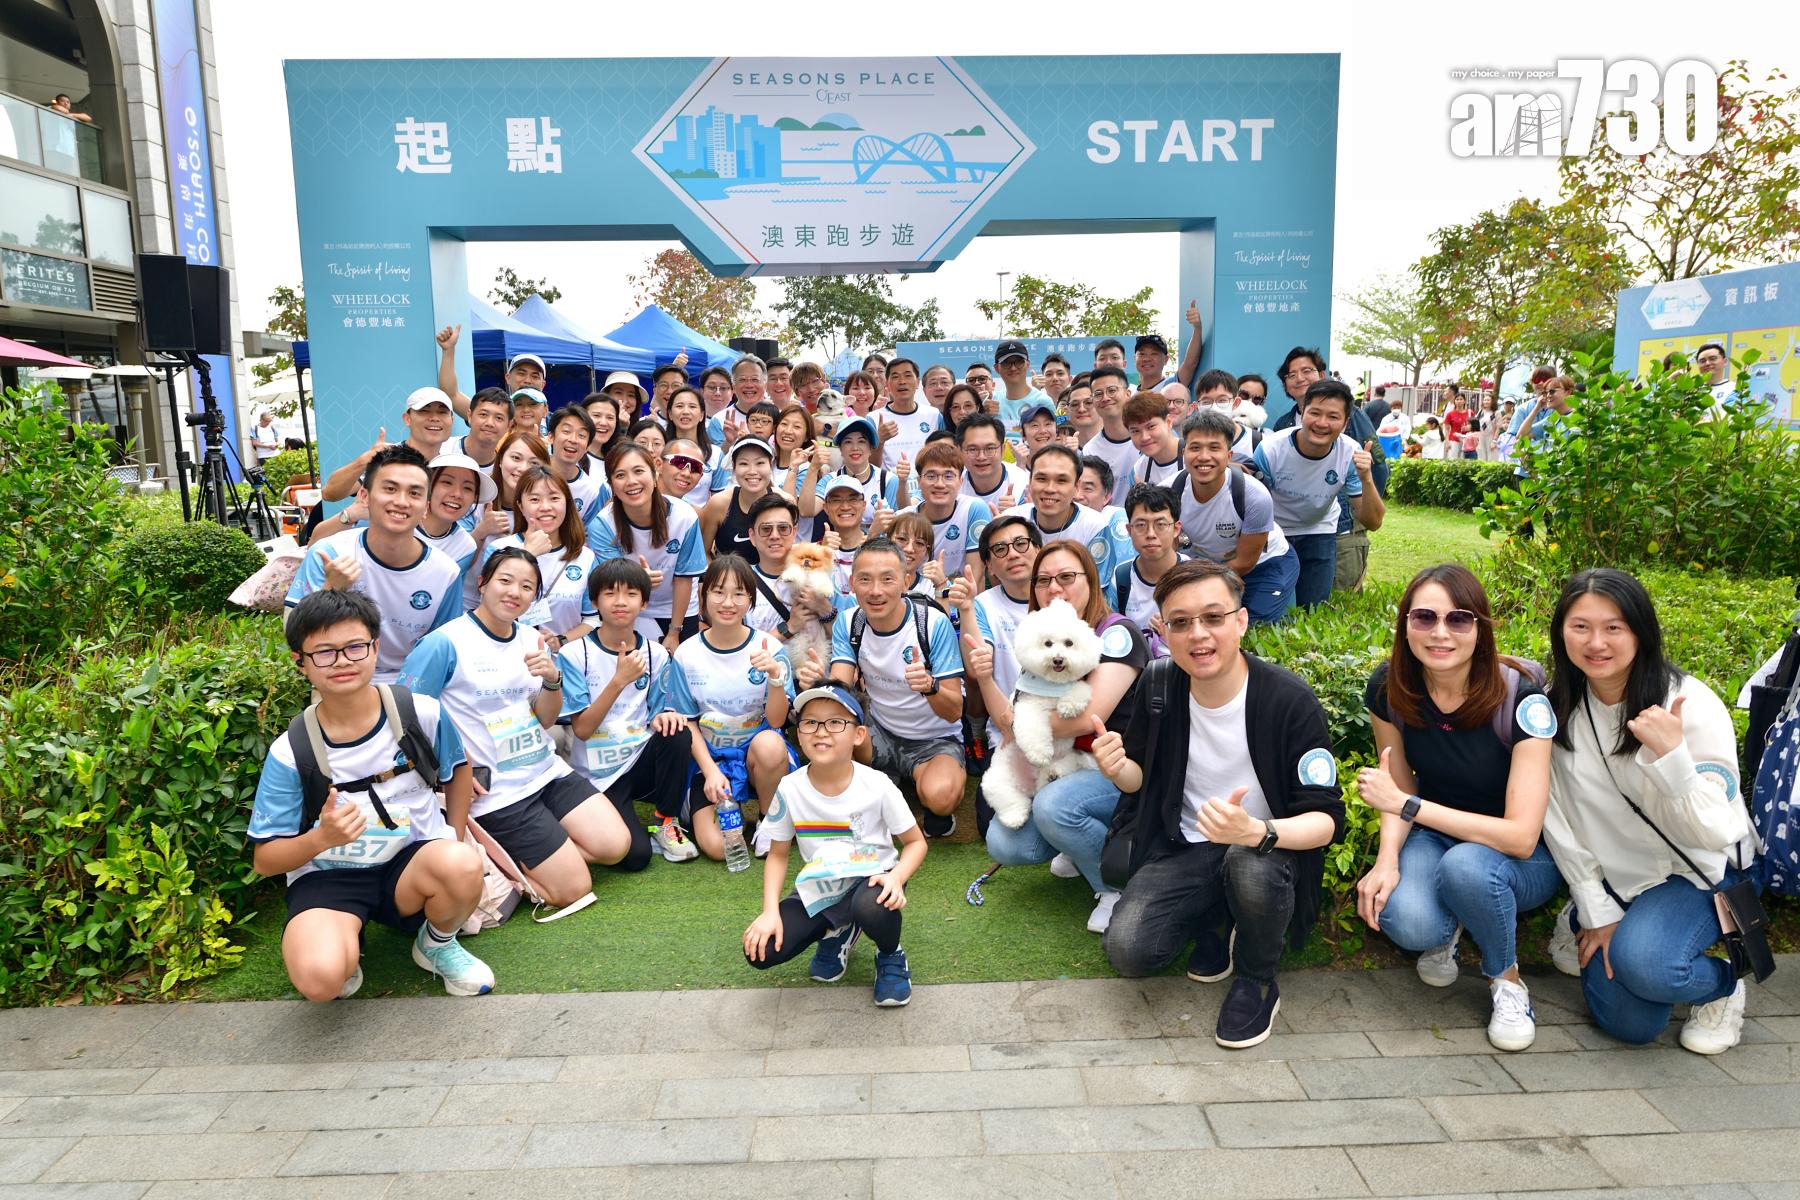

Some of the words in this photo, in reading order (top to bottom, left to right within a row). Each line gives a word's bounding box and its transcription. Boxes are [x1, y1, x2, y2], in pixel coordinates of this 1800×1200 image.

[732, 72, 846, 85] SEASONS
[860, 72, 935, 85] PLACE
[394, 116, 563, 174] 起點
[1086, 118, 1275, 165] START
[184, 106, 206, 219] O'SOUTH
[196, 227, 210, 265] CO
[761, 223, 915, 248] 澳東跑步遊
[1234, 250, 1248, 263] The
[1248, 250, 1276, 266] Spirit
[1277, 249, 1286, 268] of
[1286, 248, 1312, 269] Living
[16, 263, 75, 283] FRITES
[327, 262, 344, 275] The
[344, 261, 372, 279] Spirit
[374, 261, 383, 281] of
[384, 261, 411, 281] Living
[1235, 279, 1309, 291] WHEELOCK
[1723, 281, 1780, 307] 資訊板
[331, 294, 411, 305] WHEELOCK
[938, 344, 994, 354] SEASONS
[476, 687, 524, 697] SEASONS
[508, 728, 543, 754] 1138
